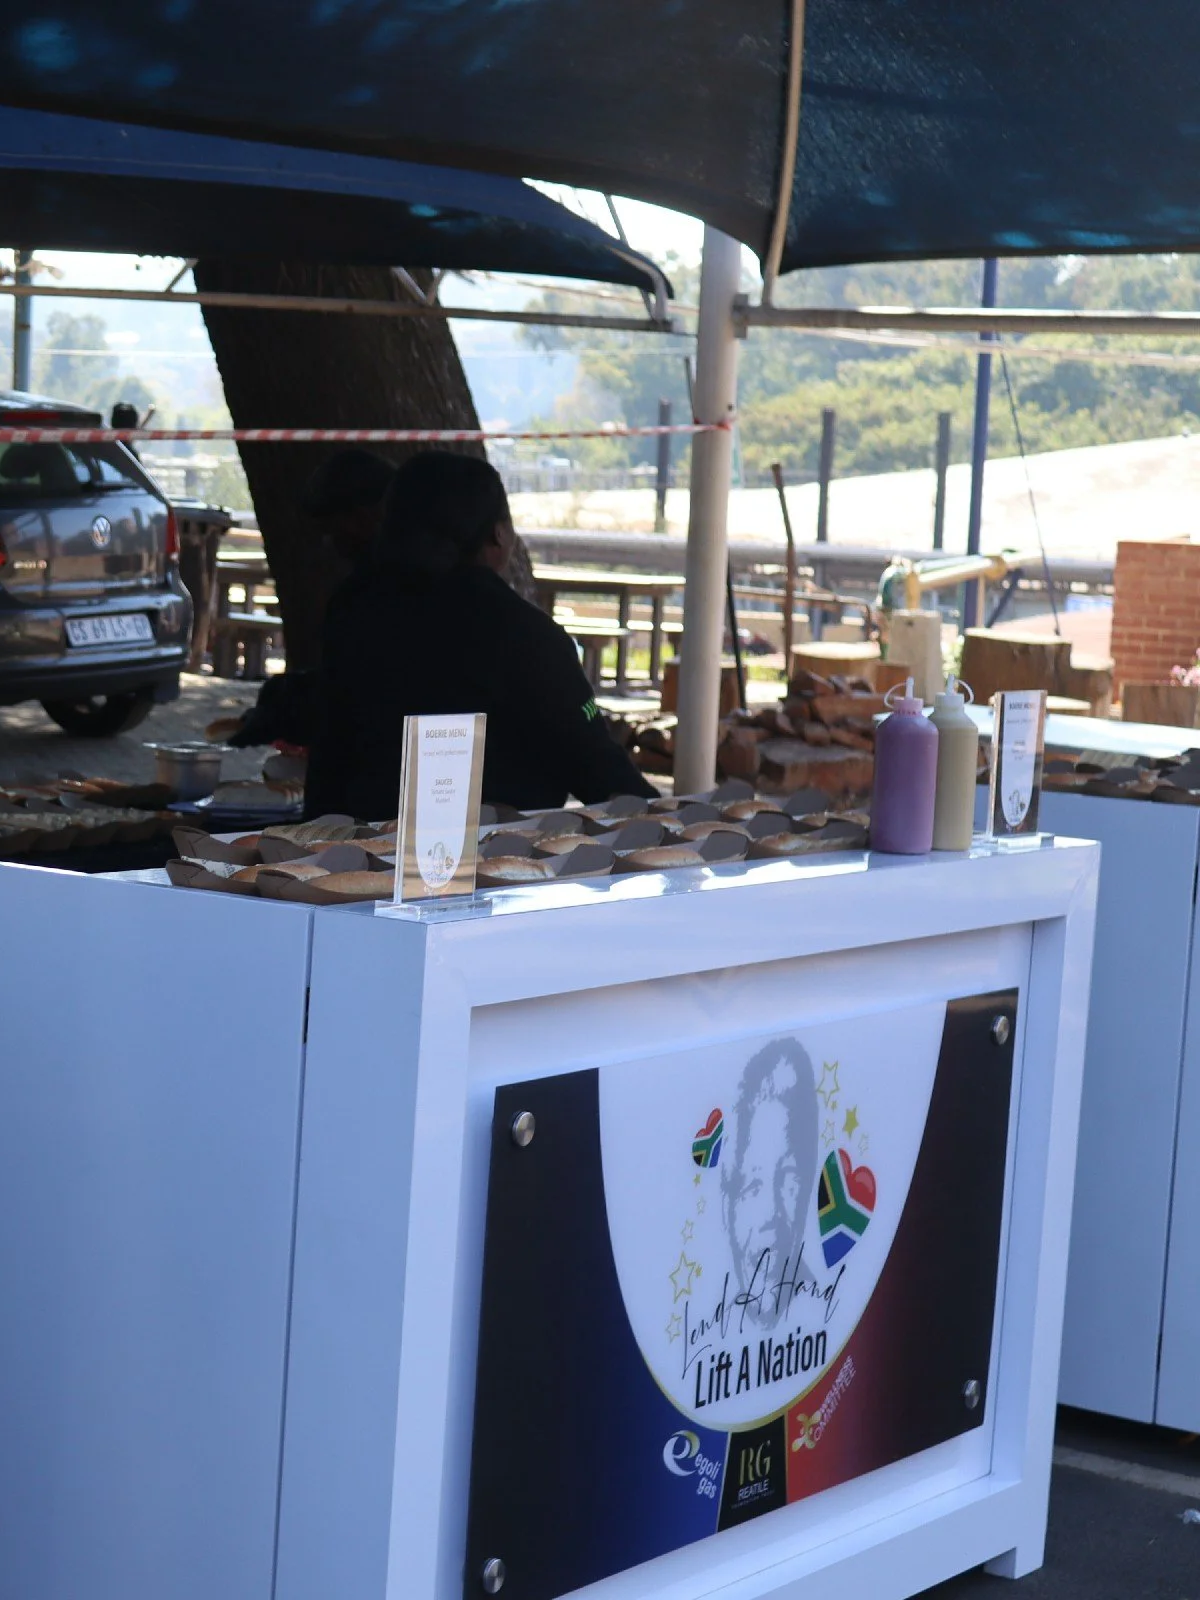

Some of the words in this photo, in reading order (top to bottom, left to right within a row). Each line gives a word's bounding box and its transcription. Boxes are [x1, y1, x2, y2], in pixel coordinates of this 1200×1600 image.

[425, 729, 447, 739] BOERIE
[448, 728, 467, 738] MENU
[735, 1247, 770, 1334] A
[770, 1241, 846, 1324] Hand
[694, 1350, 733, 1409] Lift
[735, 1345, 750, 1395] A
[756, 1326, 828, 1388] Nation
[694, 1453, 722, 1481] egoli
[739, 1440, 771, 1486] RG
[696, 1477, 717, 1499] gas
[738, 1479, 770, 1501] REATILE
